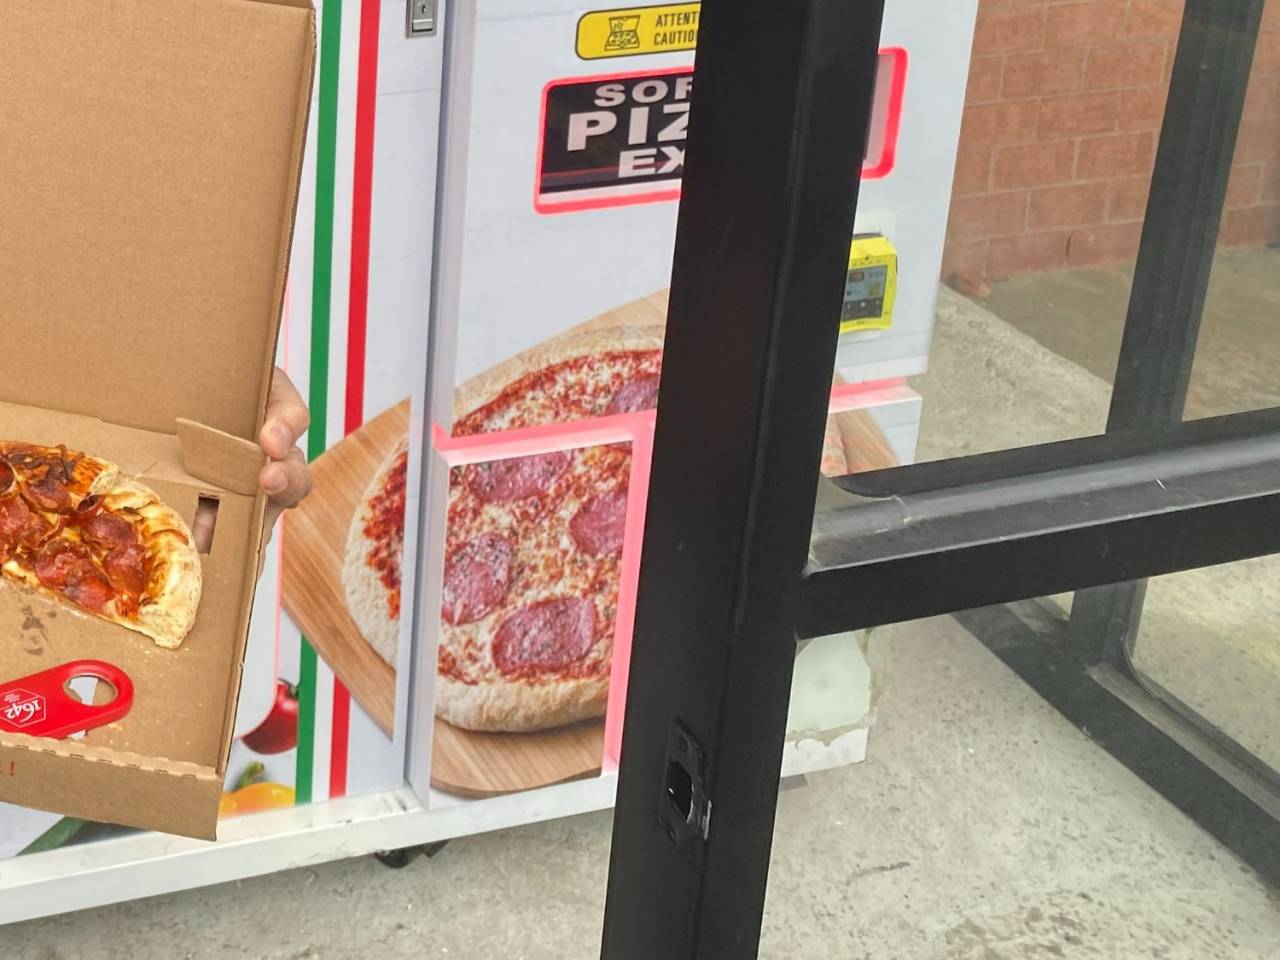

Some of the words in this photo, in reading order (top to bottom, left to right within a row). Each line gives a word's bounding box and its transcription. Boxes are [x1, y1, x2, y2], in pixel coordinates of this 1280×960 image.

[656, 11, 698, 28] ATTENT
[654, 29, 696, 46] CAUTIO
[566, 102, 690, 152] PIZ
[618, 145, 685, 178] EX
[4, 698, 43, 724] 1642
